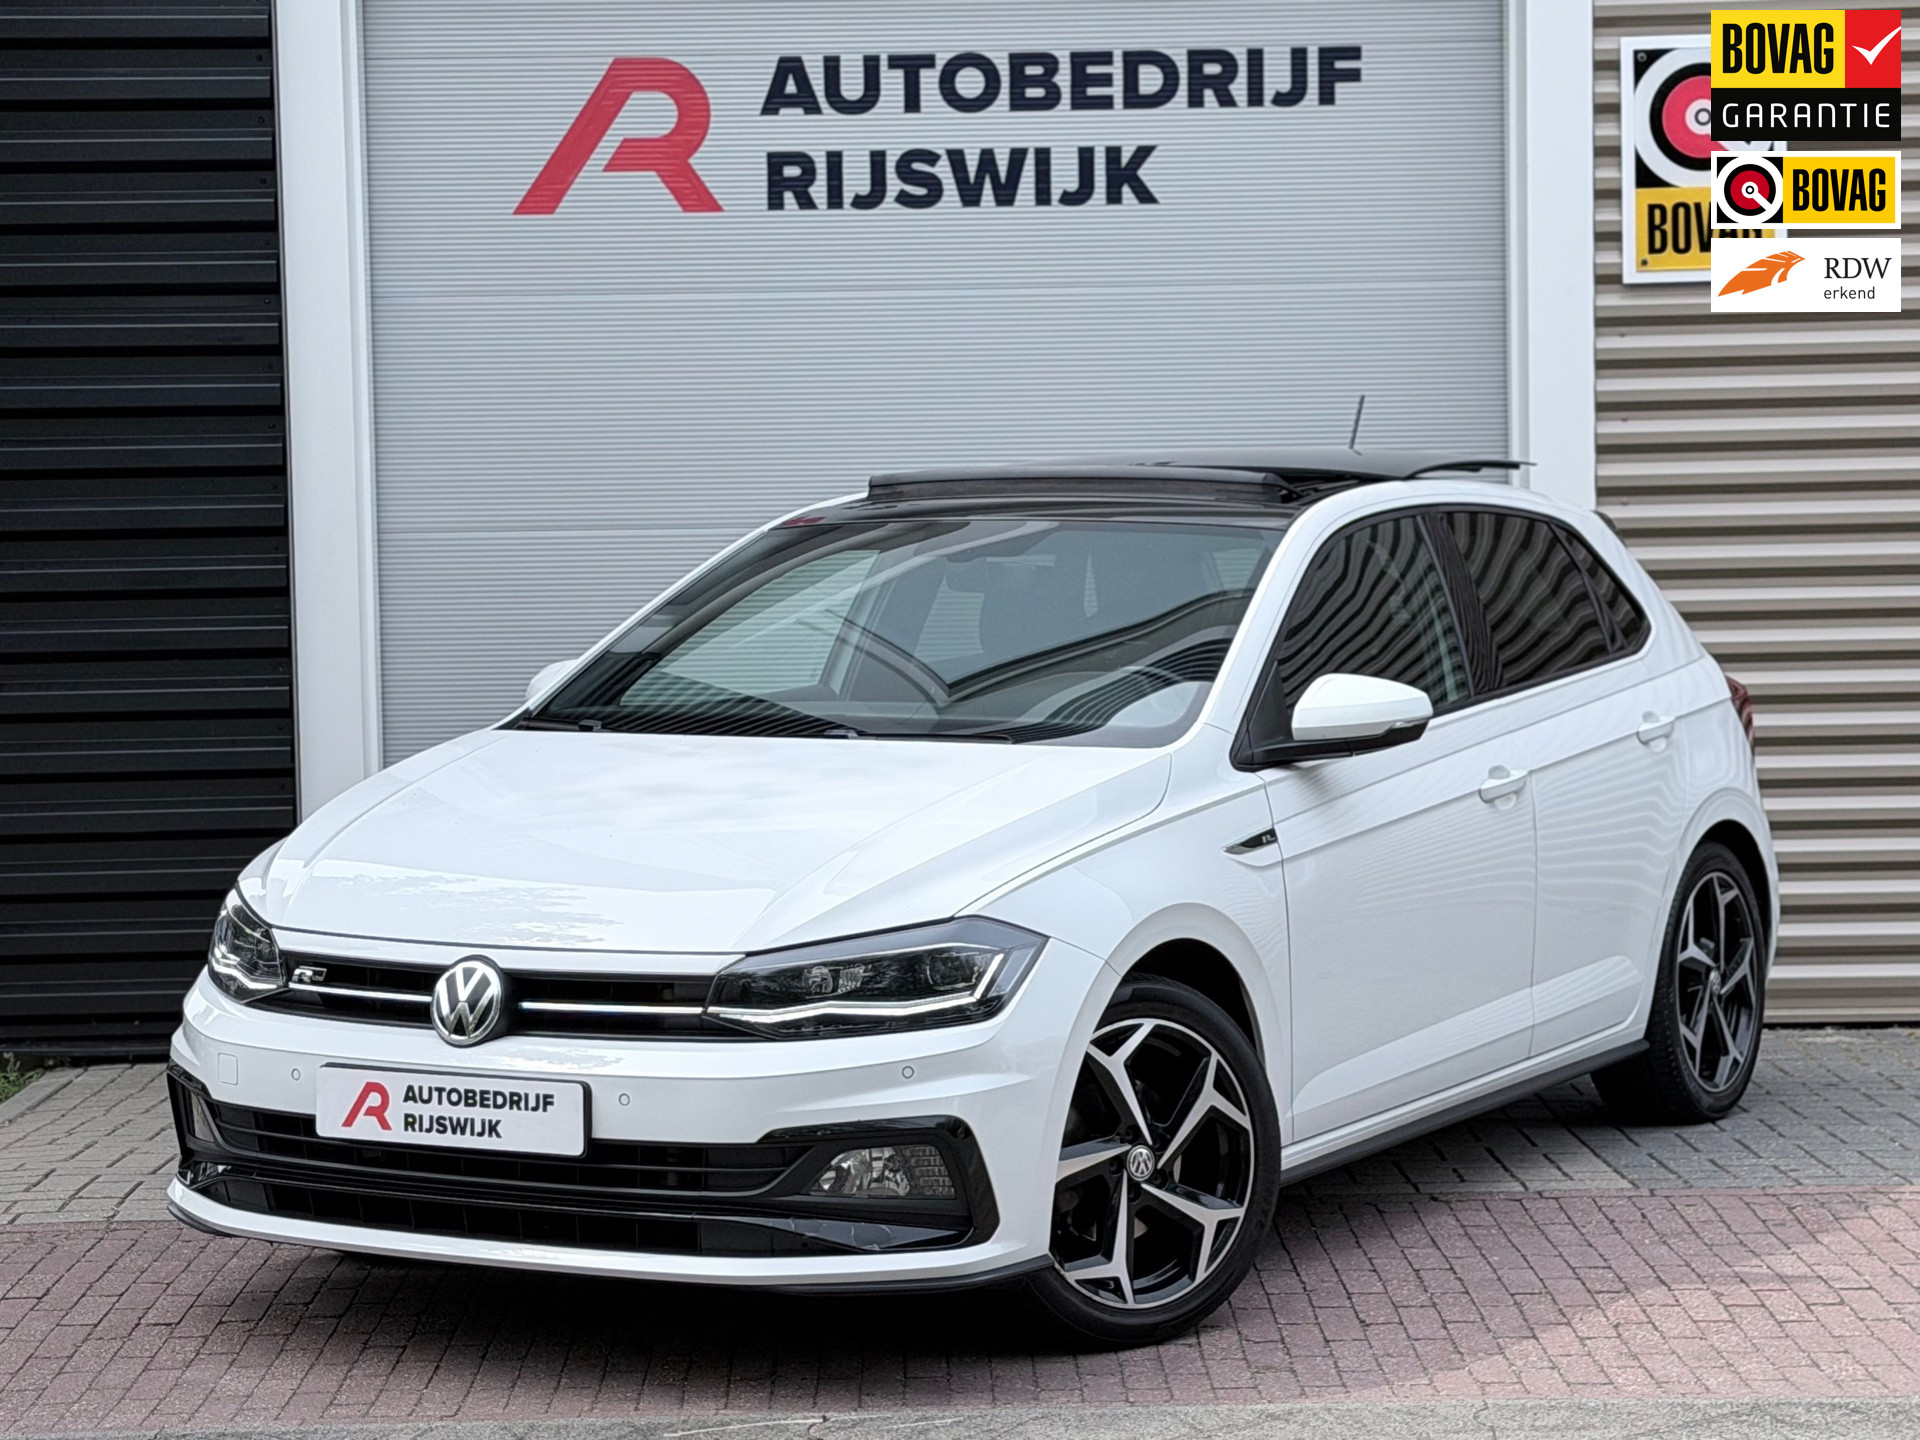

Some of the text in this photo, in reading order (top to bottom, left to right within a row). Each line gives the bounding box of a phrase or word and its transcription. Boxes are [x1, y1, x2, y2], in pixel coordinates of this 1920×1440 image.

[761, 46, 1363, 117] AUTOBEDRIJF
[766, 145, 1160, 212] RIJSWIJK
[1647, 201, 1763, 255] BOV
[402, 1084, 555, 1113] AUTOBEDRIJF
[403, 1113, 502, 1139] RIJSWIJK
